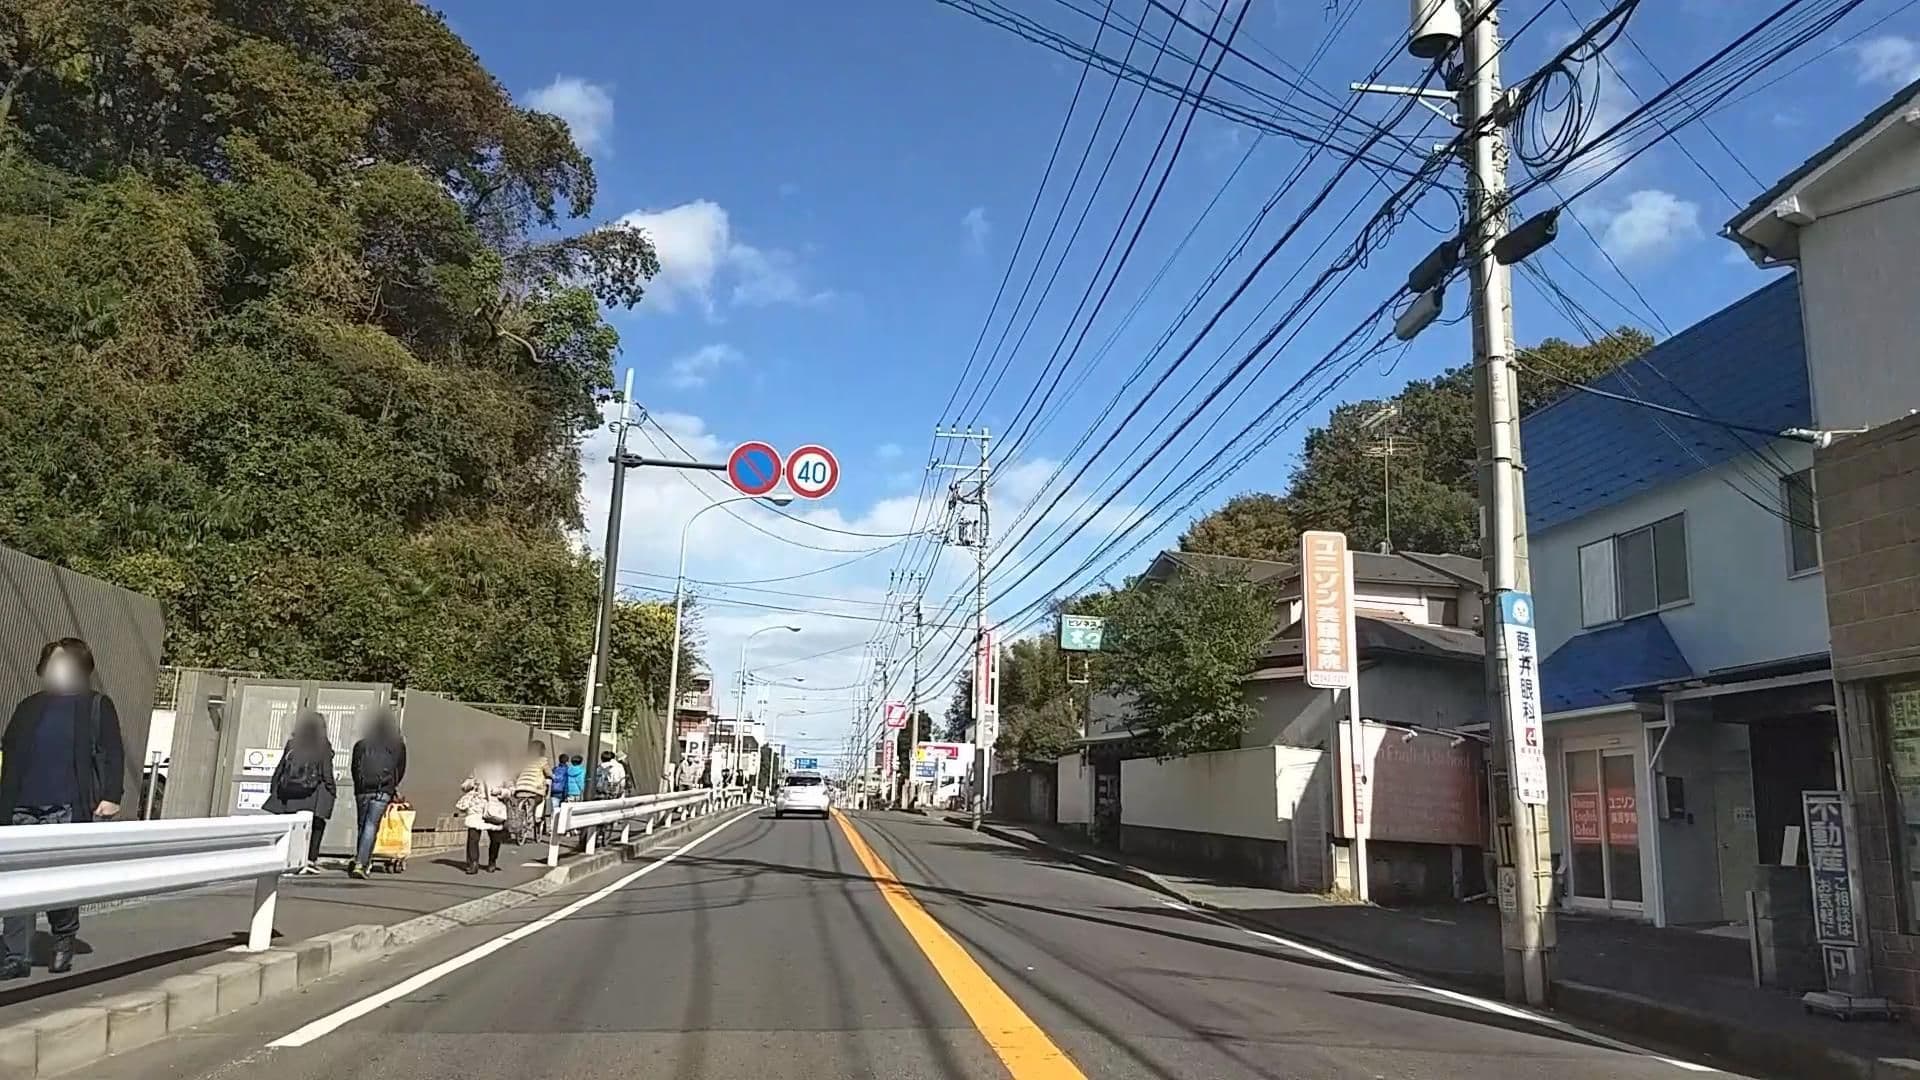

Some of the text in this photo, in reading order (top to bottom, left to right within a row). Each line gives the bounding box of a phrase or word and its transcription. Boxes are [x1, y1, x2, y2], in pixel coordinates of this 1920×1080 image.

[798, 461, 826, 483] 40
[1516, 630, 1536, 723] 藤井眼科
[1807, 797, 1845, 872] 不動産
[1829, 951, 1847, 978] P
